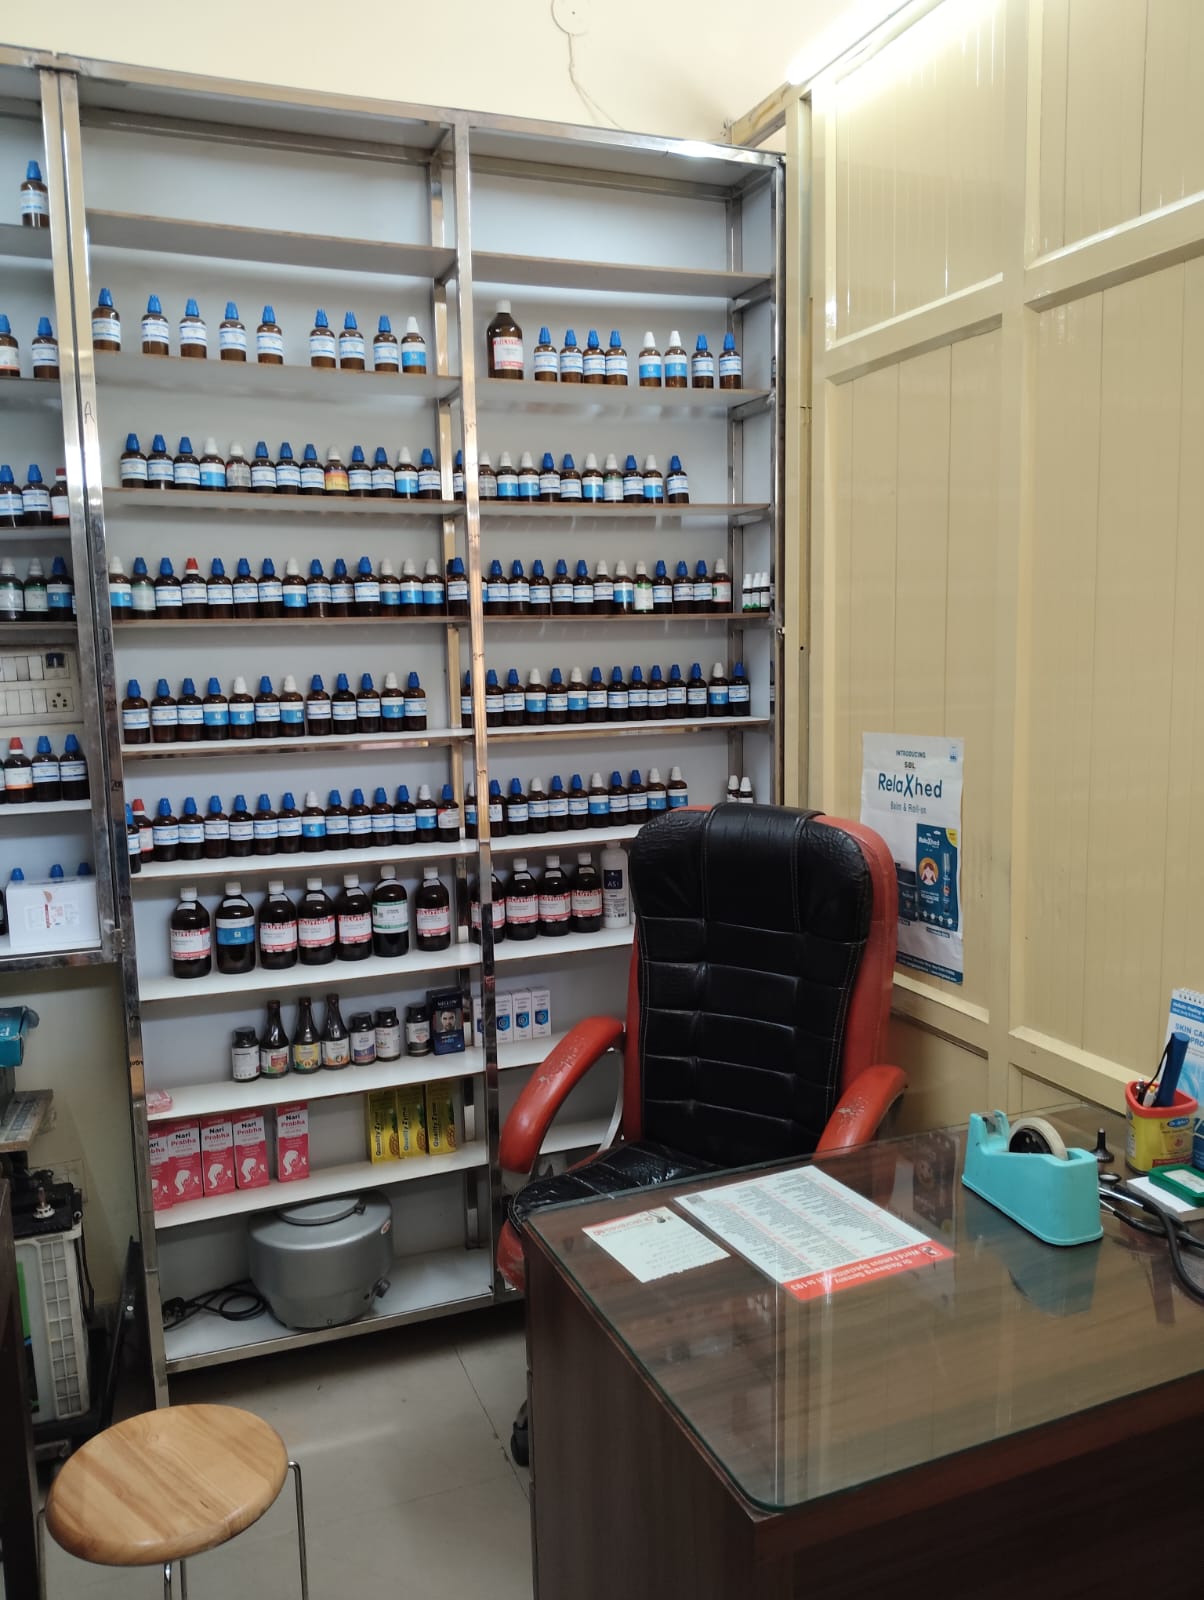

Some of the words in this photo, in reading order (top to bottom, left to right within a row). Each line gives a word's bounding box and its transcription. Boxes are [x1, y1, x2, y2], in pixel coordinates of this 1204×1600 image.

[896, 750, 926, 759] INTRODUCING
[878, 772, 943, 798] RelaXhed
[1175, 1022, 1192, 1034] SKIN
[242, 1121, 256, 1129] Nari
[281, 1119, 305, 1128] Prabha
[209, 1126, 224, 1134] Nari
[237, 1127, 262, 1136] Prabha
[175, 1132, 190, 1140] Nari
[204, 1132, 230, 1141] Prabha
[171, 1138, 196, 1147] Prabha
